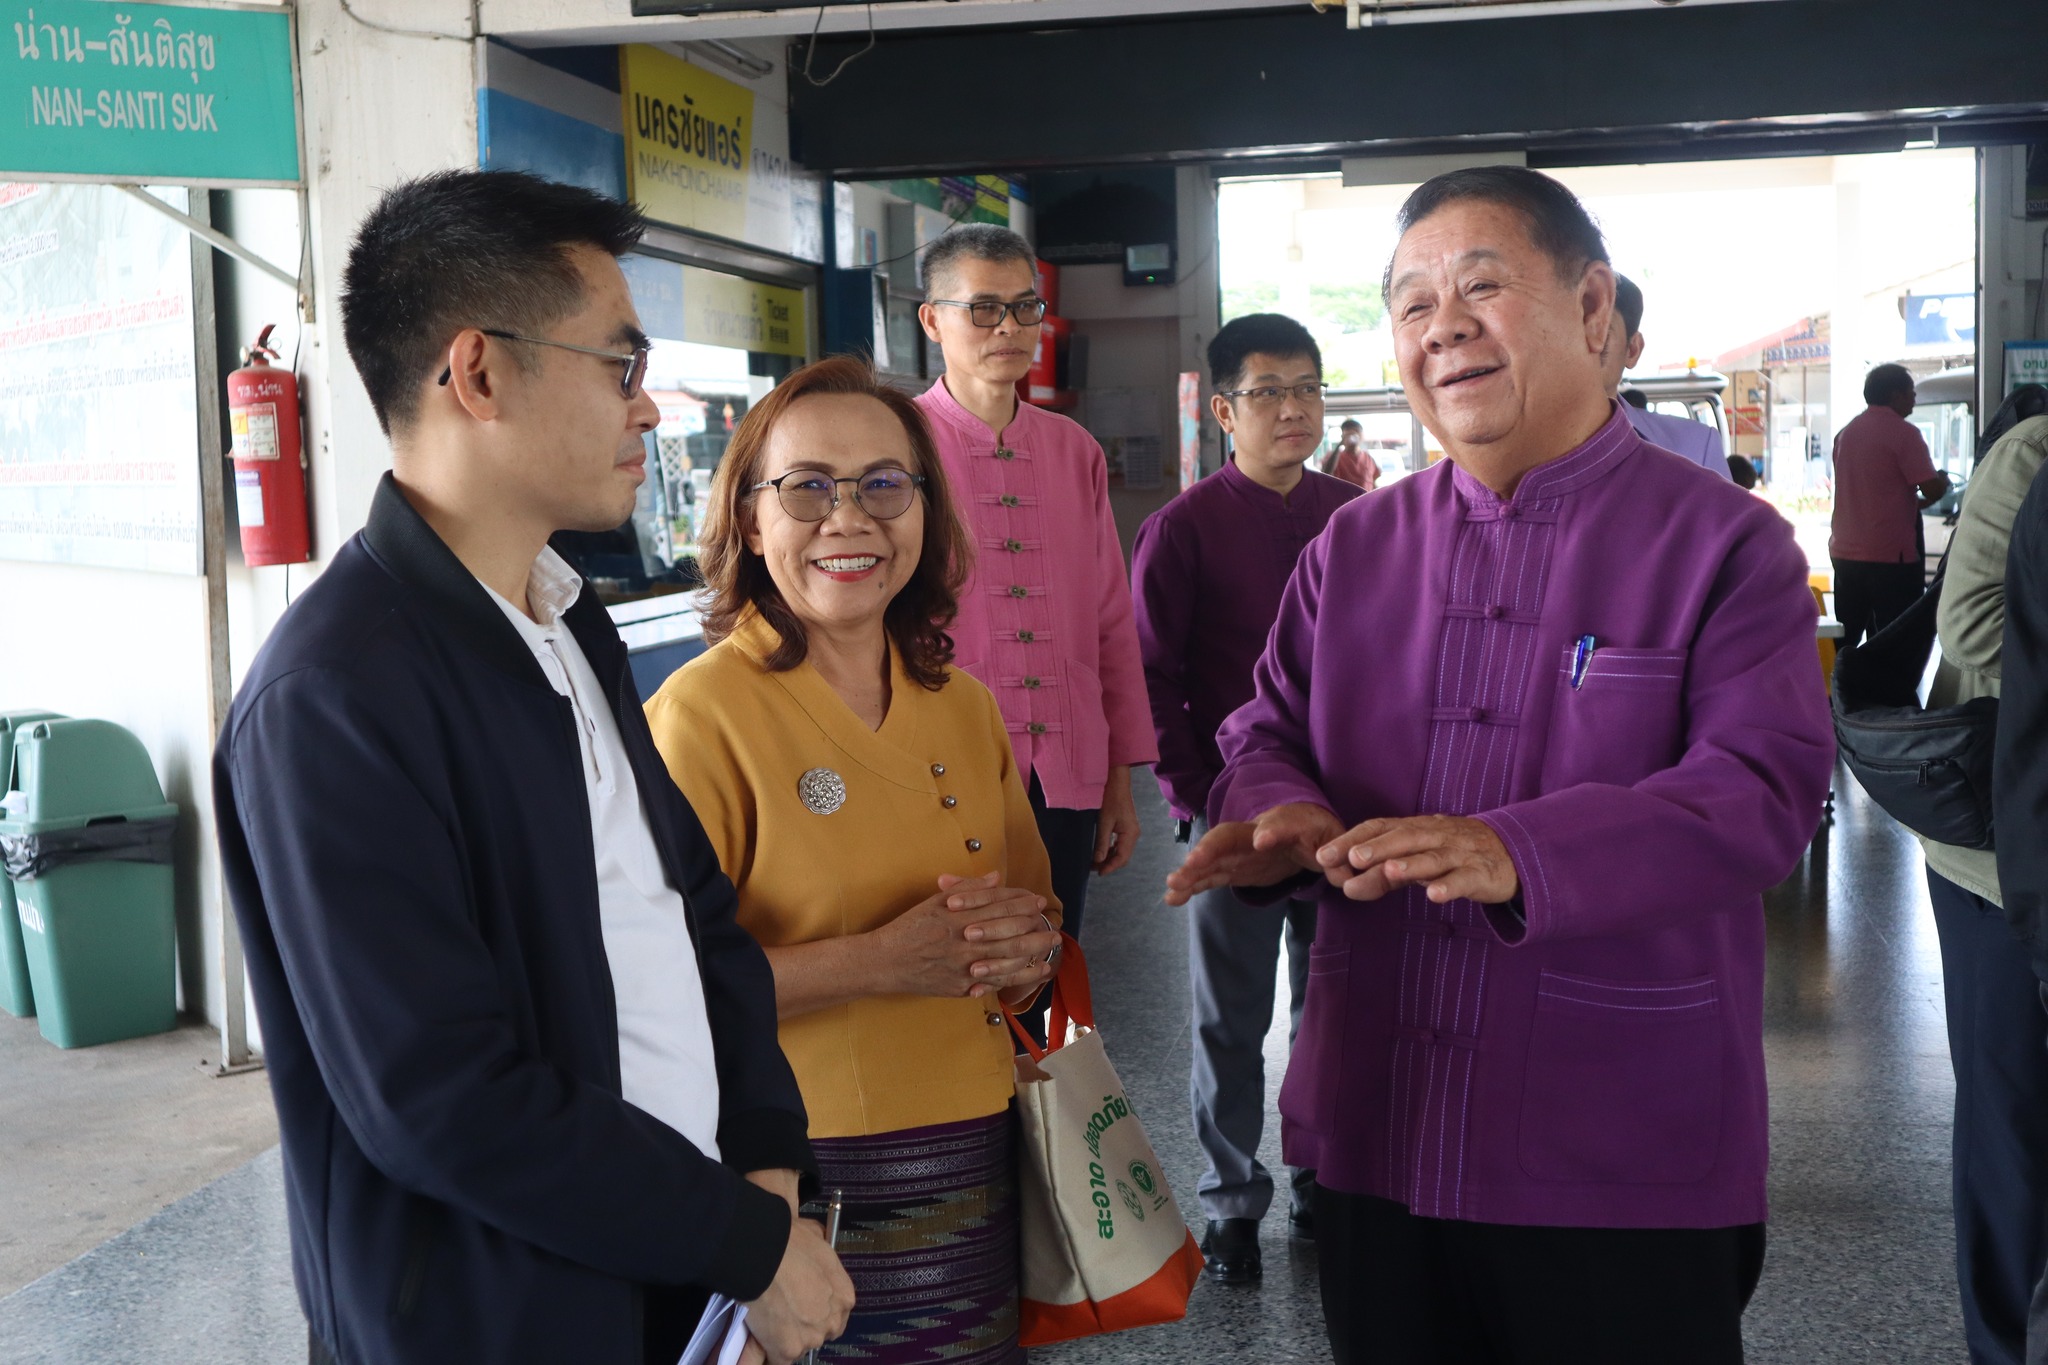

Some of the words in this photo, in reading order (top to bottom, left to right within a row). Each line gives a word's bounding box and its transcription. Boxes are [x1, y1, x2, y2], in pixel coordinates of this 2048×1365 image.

[31, 86, 166, 130] NAN-SANTI
[171, 92, 218, 132] SUK
[635, 92, 742, 170] นครชัยแอร์
